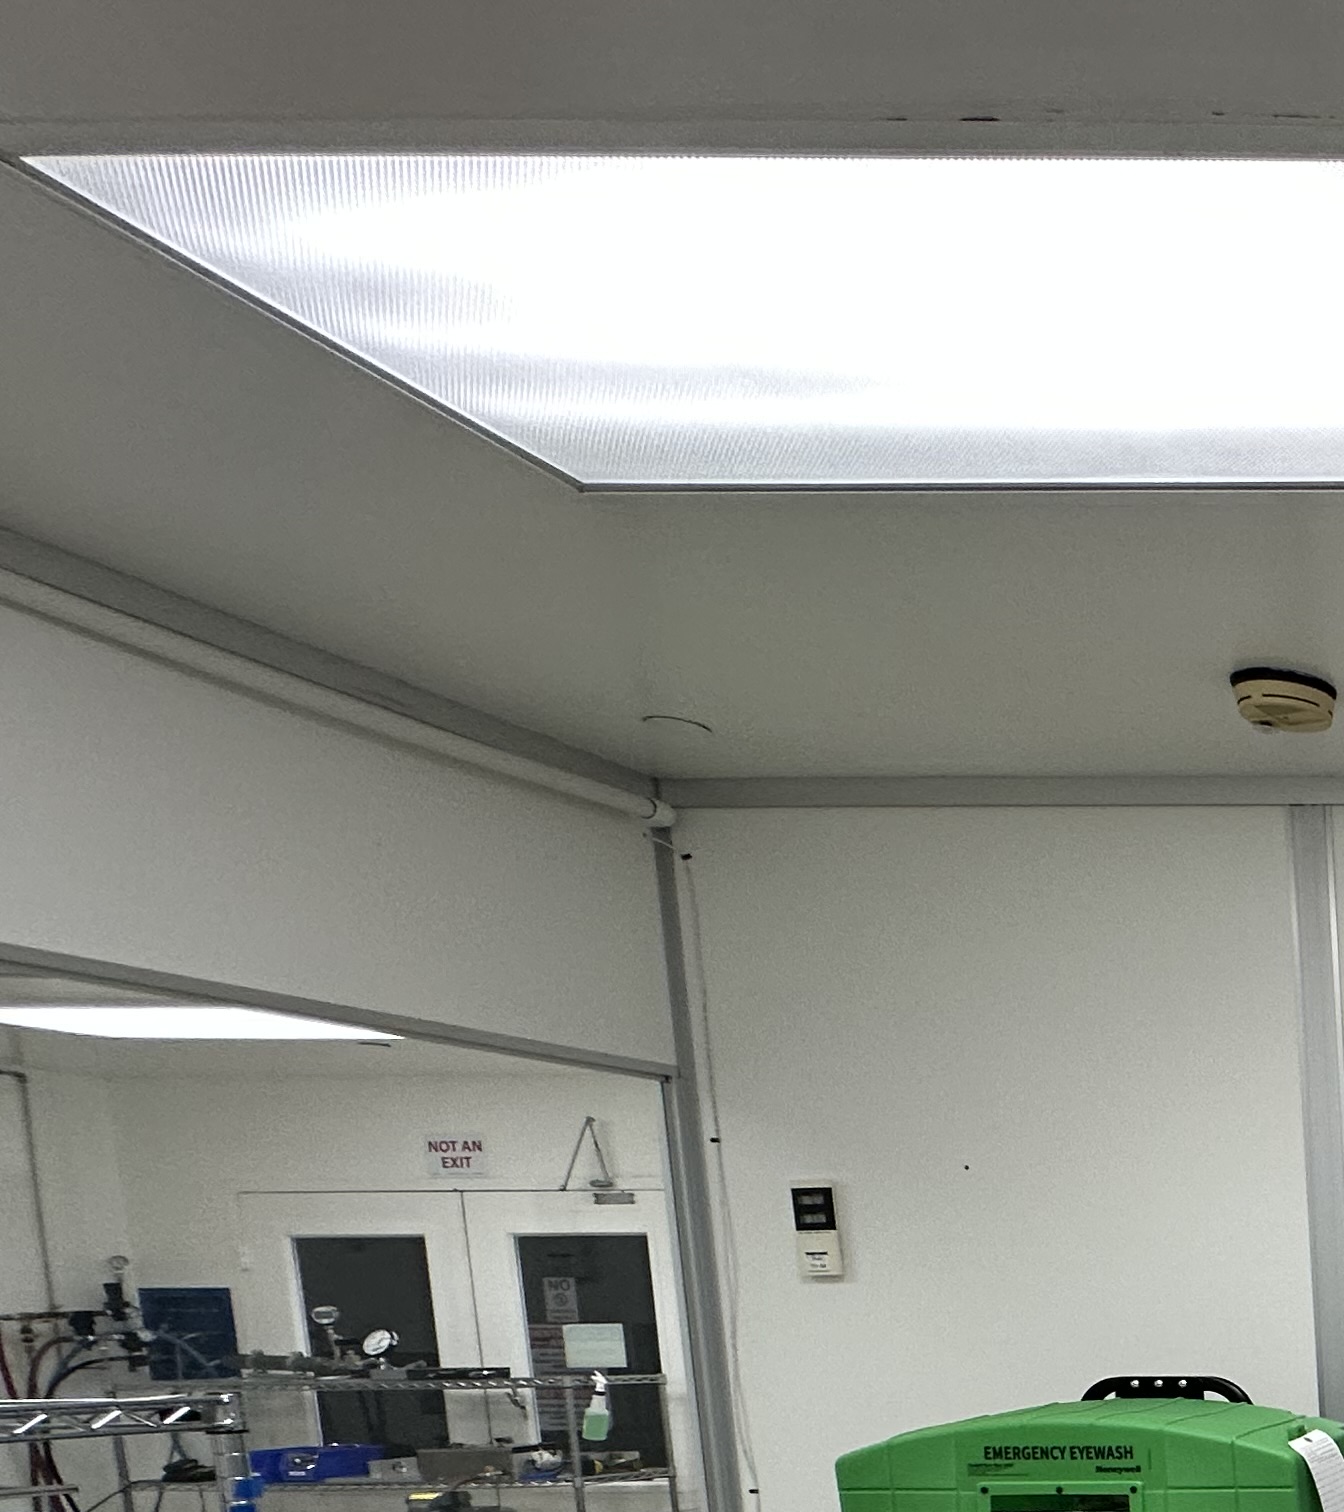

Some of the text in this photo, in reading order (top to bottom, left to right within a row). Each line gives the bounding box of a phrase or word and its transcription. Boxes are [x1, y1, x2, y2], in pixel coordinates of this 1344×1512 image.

[428, 1140, 482, 1152] NOT AN
[441, 1156, 472, 1168] EXIT
[984, 1445, 1134, 1460] EMERGENCY EYEWASH
